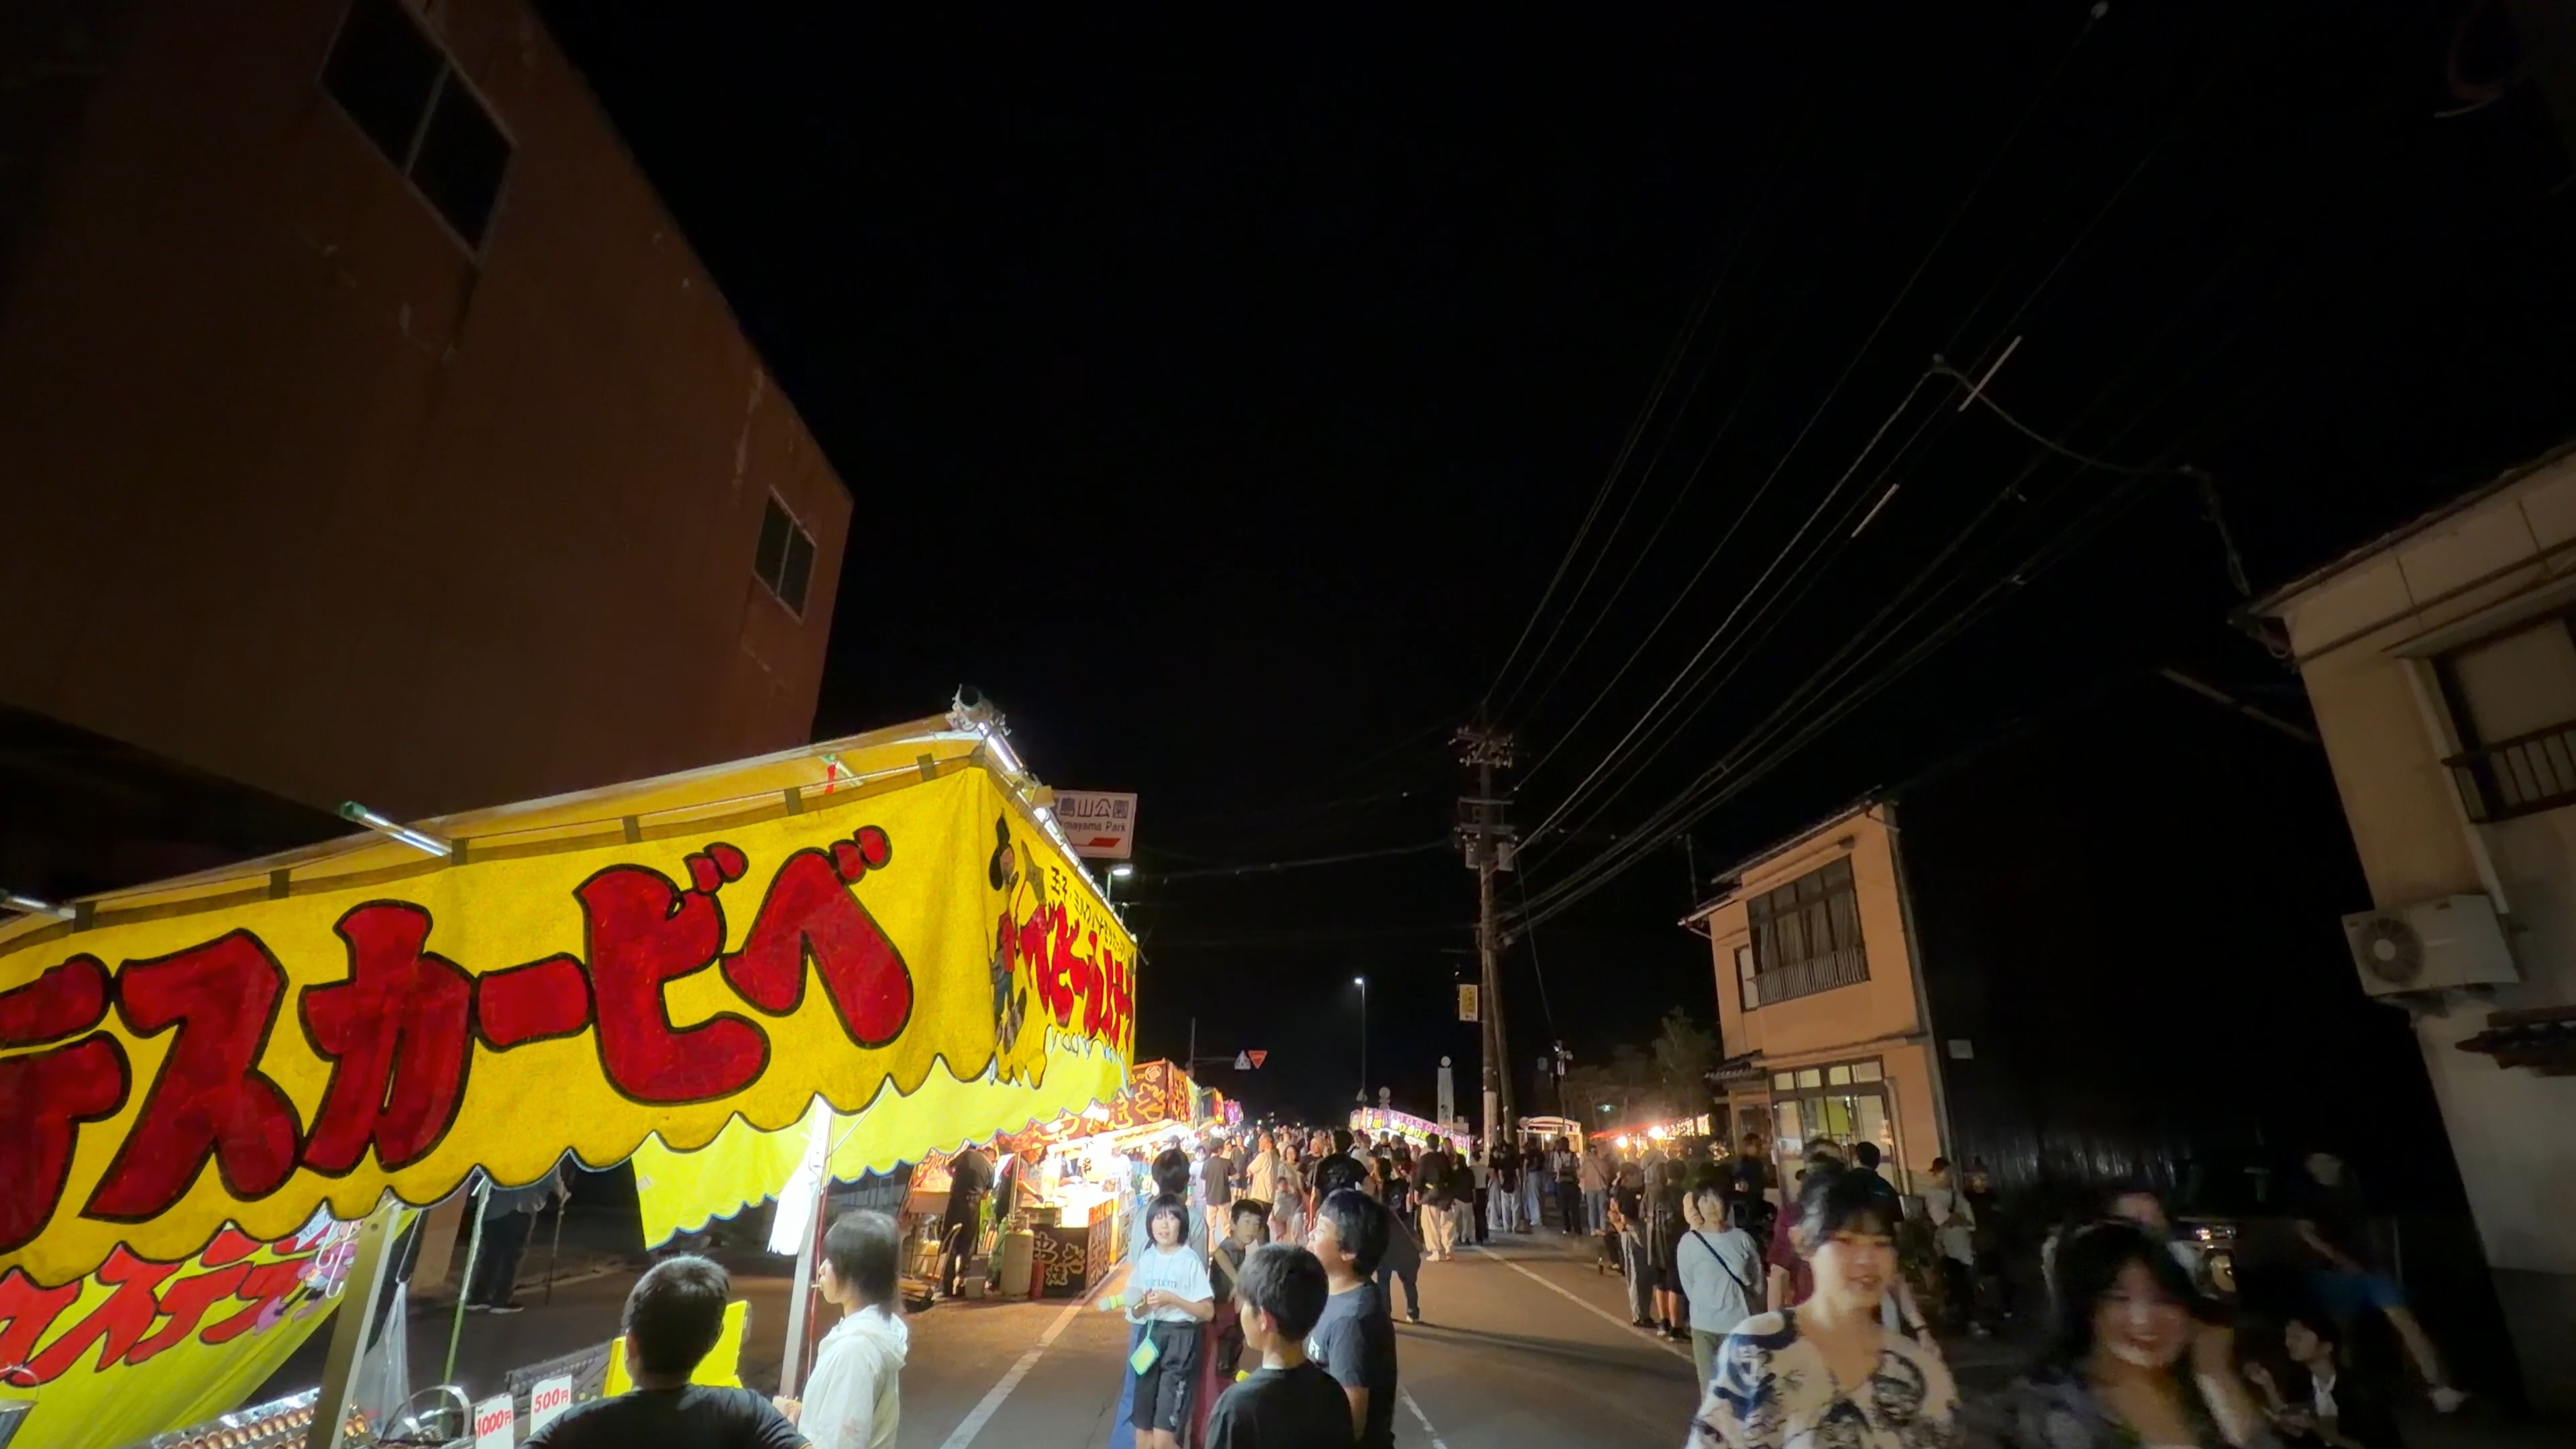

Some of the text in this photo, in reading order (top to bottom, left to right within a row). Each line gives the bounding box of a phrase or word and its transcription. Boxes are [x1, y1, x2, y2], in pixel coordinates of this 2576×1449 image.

[1055, 797, 1130, 819] 島山公園
[1060, 821, 1126, 833] mayama Park
[534, 1387, 569, 1413] 500円
[476, 1409, 512, 1438] 1000円
